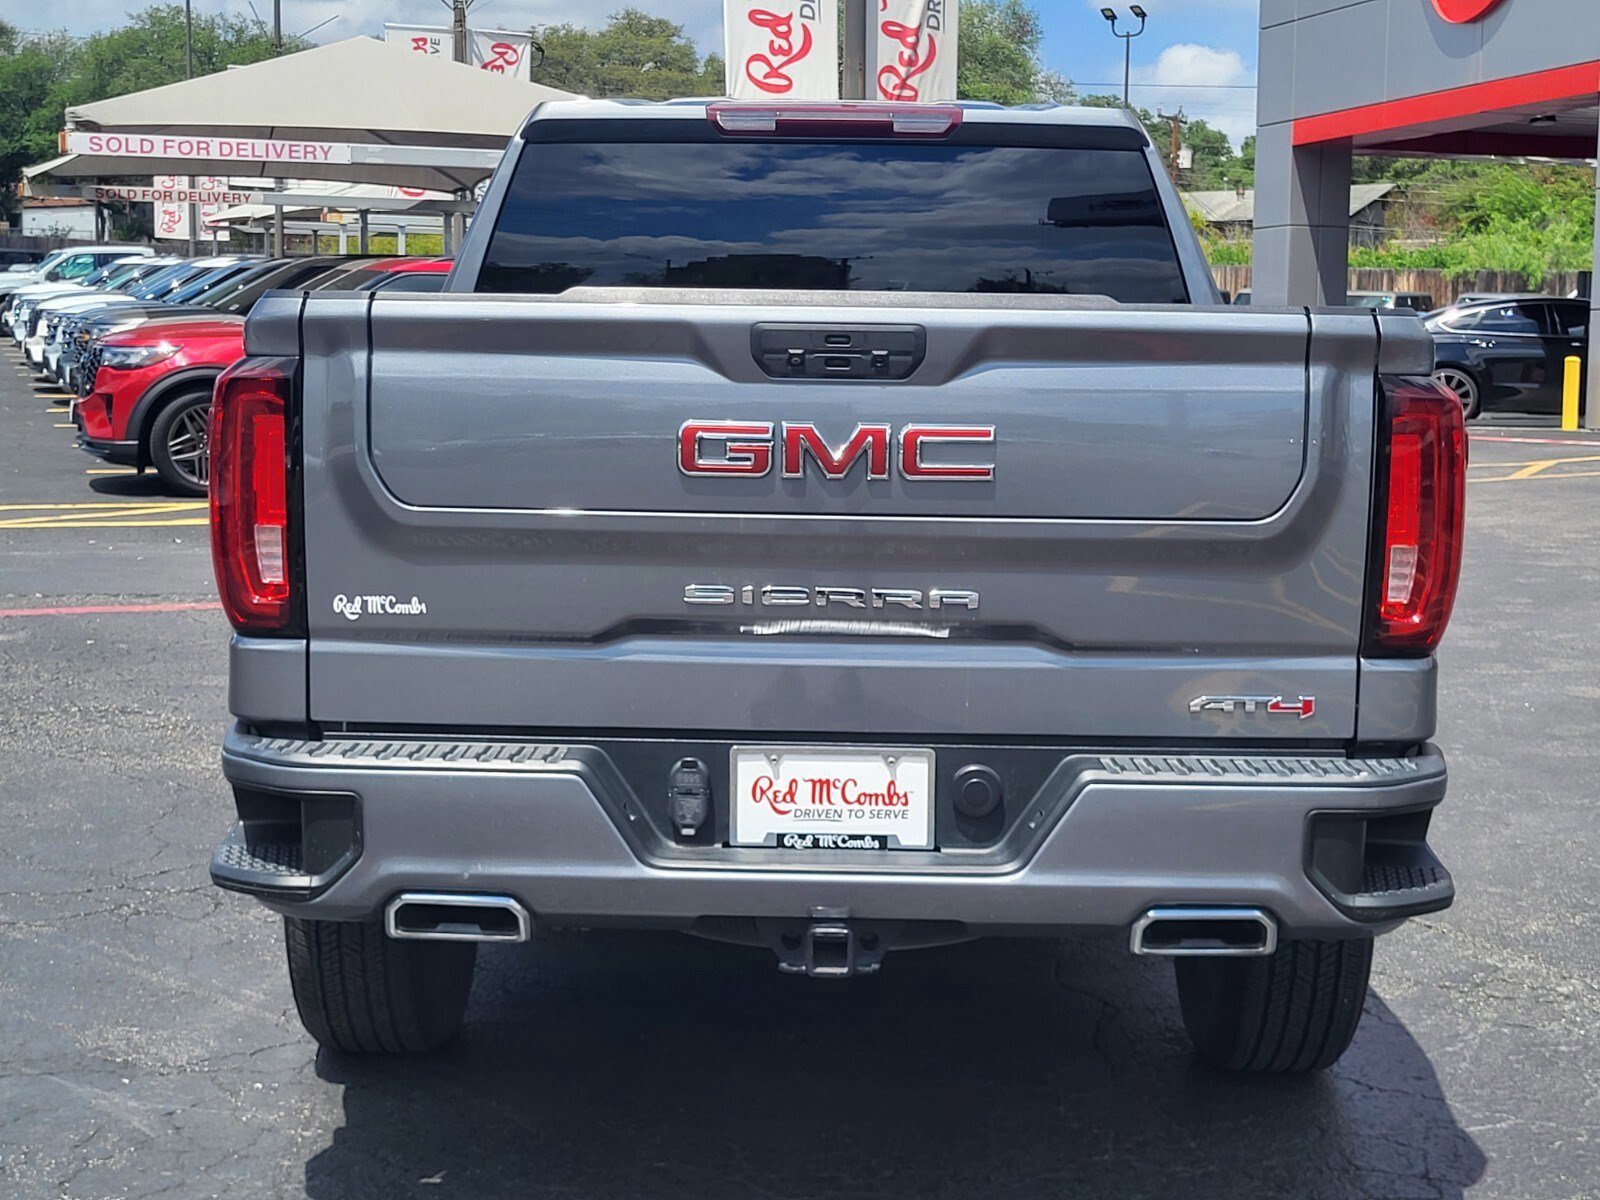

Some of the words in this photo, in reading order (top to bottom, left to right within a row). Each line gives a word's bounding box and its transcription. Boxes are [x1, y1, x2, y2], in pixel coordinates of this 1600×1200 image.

[481, 42, 519, 74] Re
[746, 9, 813, 94] Red
[877, 20, 937, 101] Red
[89, 136, 155, 154] SOLD
[163, 139, 211, 156] FOR
[219, 141, 333, 160] DELIVERY
[95, 187, 137, 199] SOLD
[142, 189, 173, 201] FOR
[178, 191, 252, 203] DELIVERY
[677, 419, 996, 482] GMC
[332, 594, 362, 620] Red
[362, 595, 427, 615] McCombs
[683, 583, 980, 610] SIERRA
[1189, 695, 1316, 719] AT4
[751, 775, 799, 815] Red
[803, 777, 909, 807] McCombs
[793, 808, 843, 819] DRIVEN
[848, 808, 865, 819] TO
[869, 809, 909, 820] SERVE
[783, 833, 814, 849] Red
[816, 834, 880, 849] McCombs
